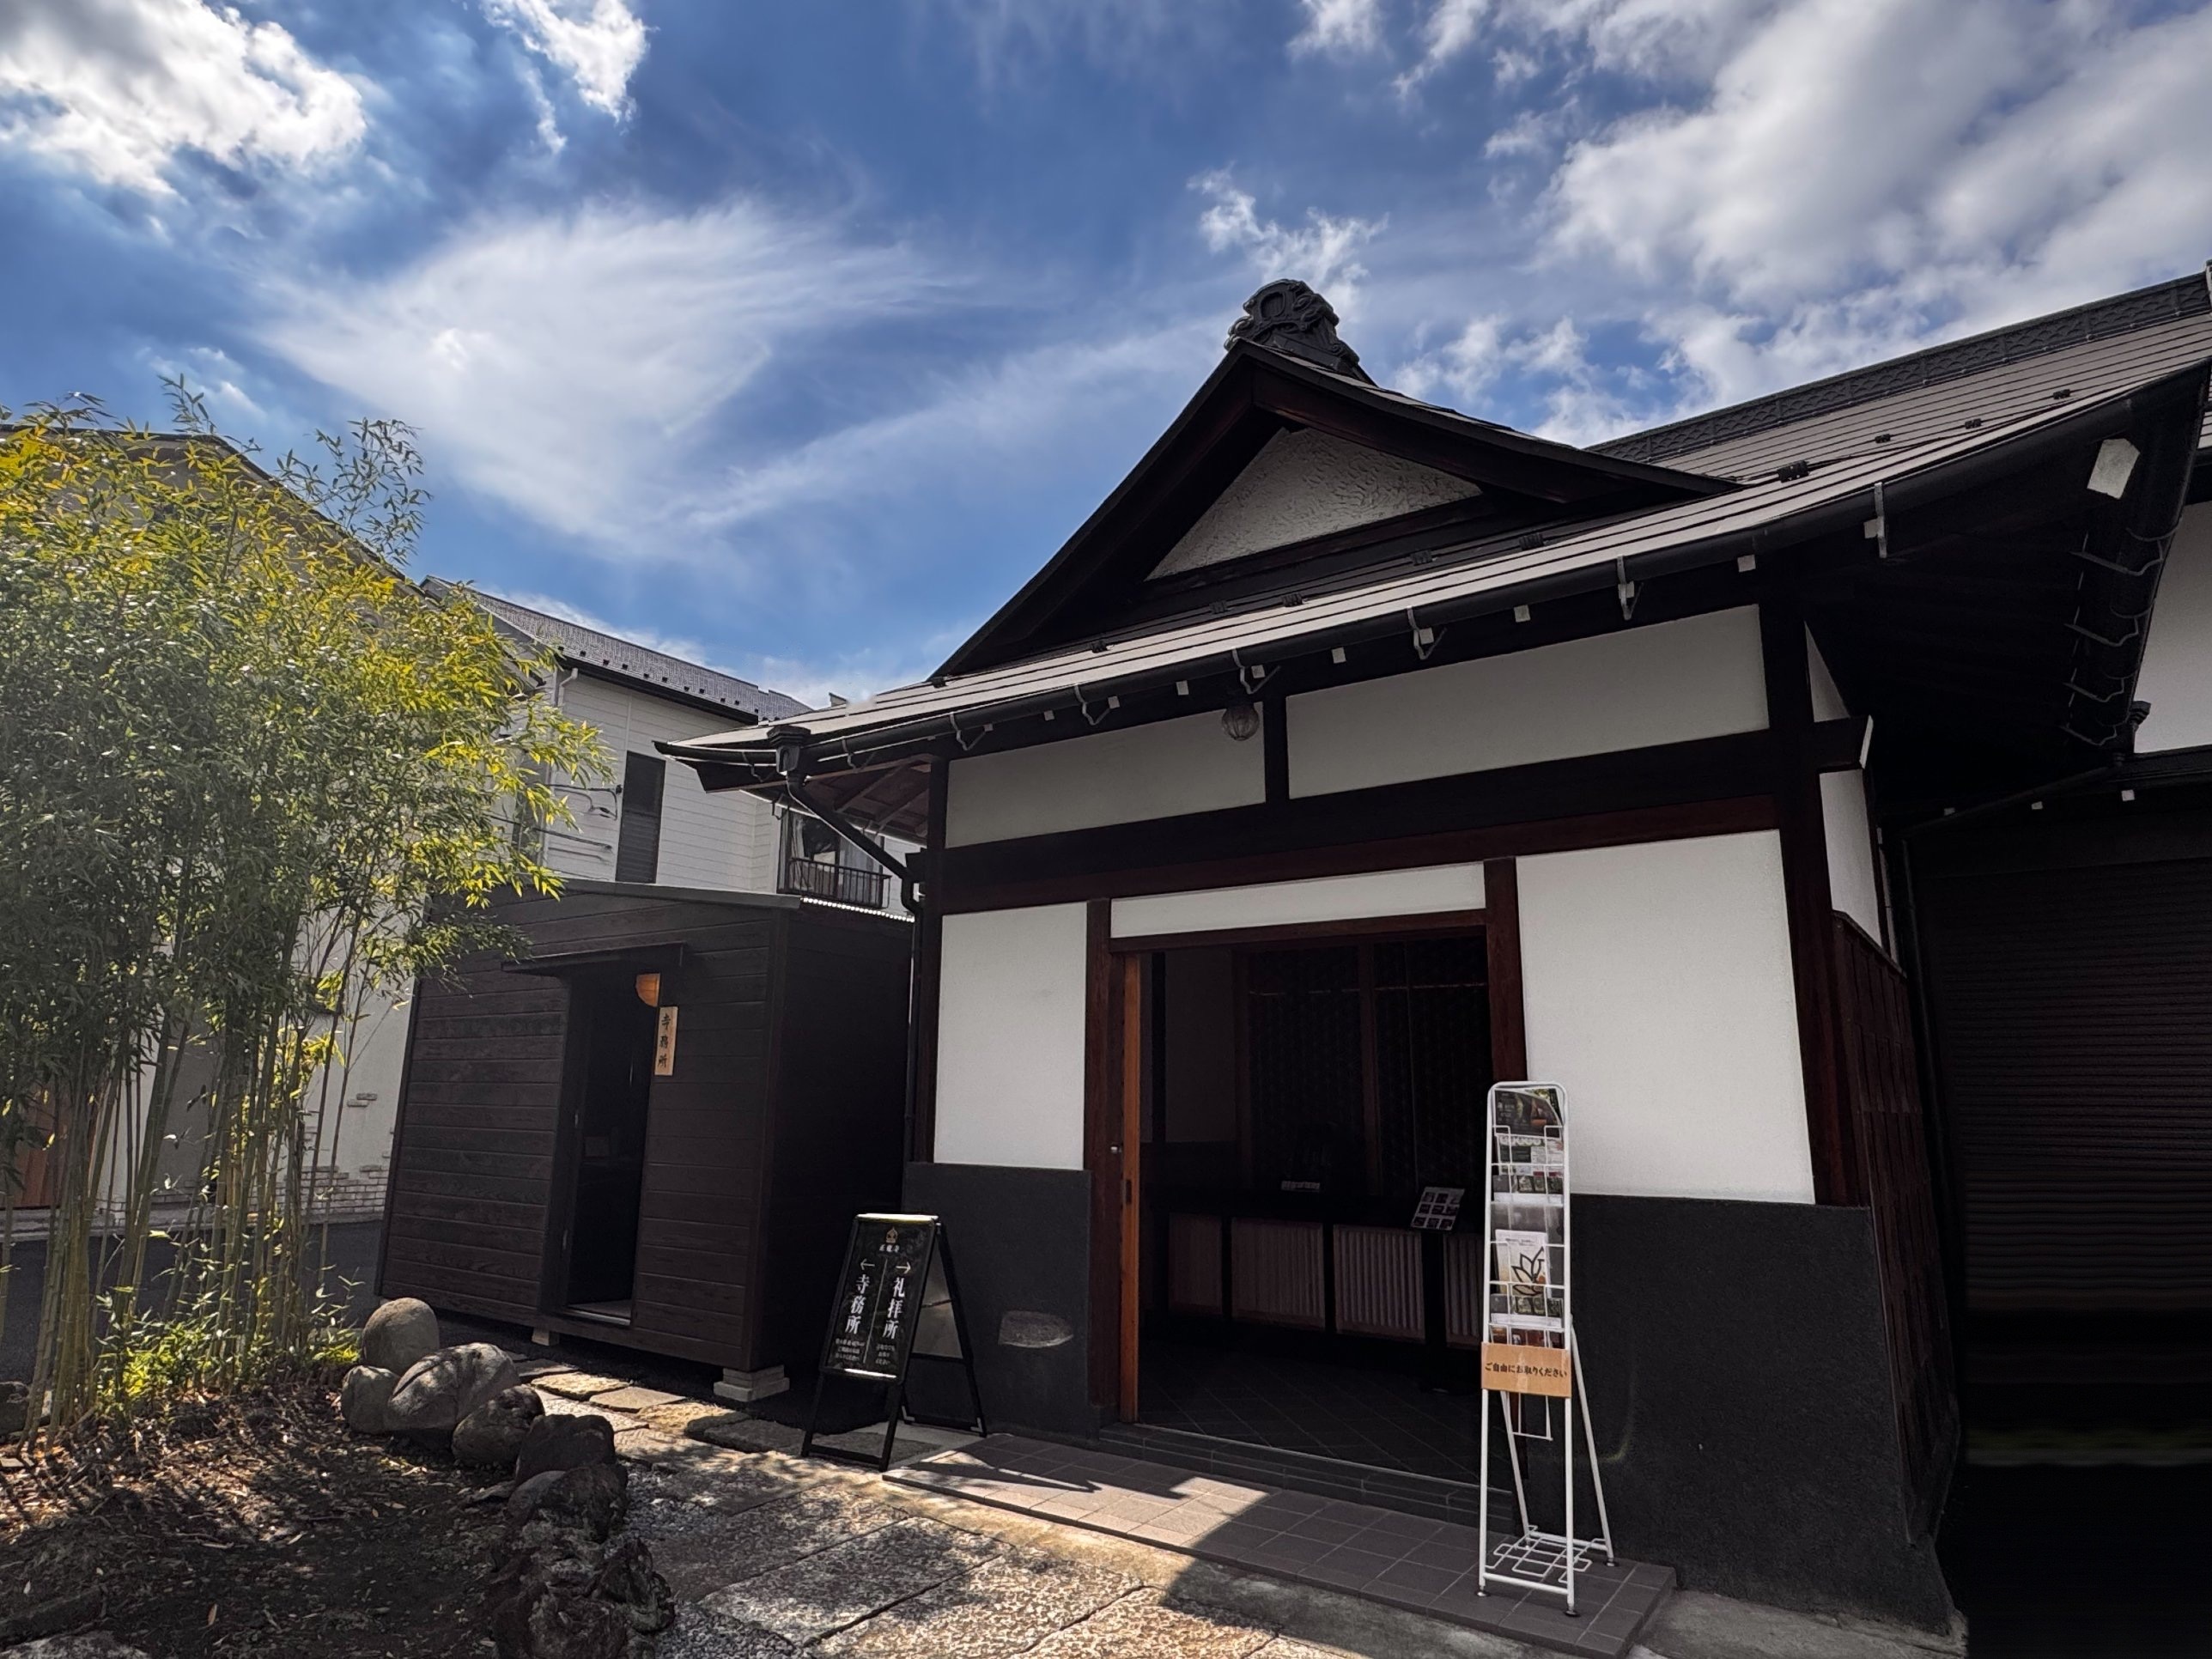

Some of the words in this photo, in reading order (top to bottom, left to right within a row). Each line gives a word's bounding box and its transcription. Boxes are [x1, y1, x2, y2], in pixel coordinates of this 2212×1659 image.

[658, 1013, 672, 1067] 寺務所
[845, 1274, 871, 1334] 寺務所
[883, 1277, 905, 1340] 礼拝所
[1485, 1363, 1567, 1377] ご自由にお取りください
